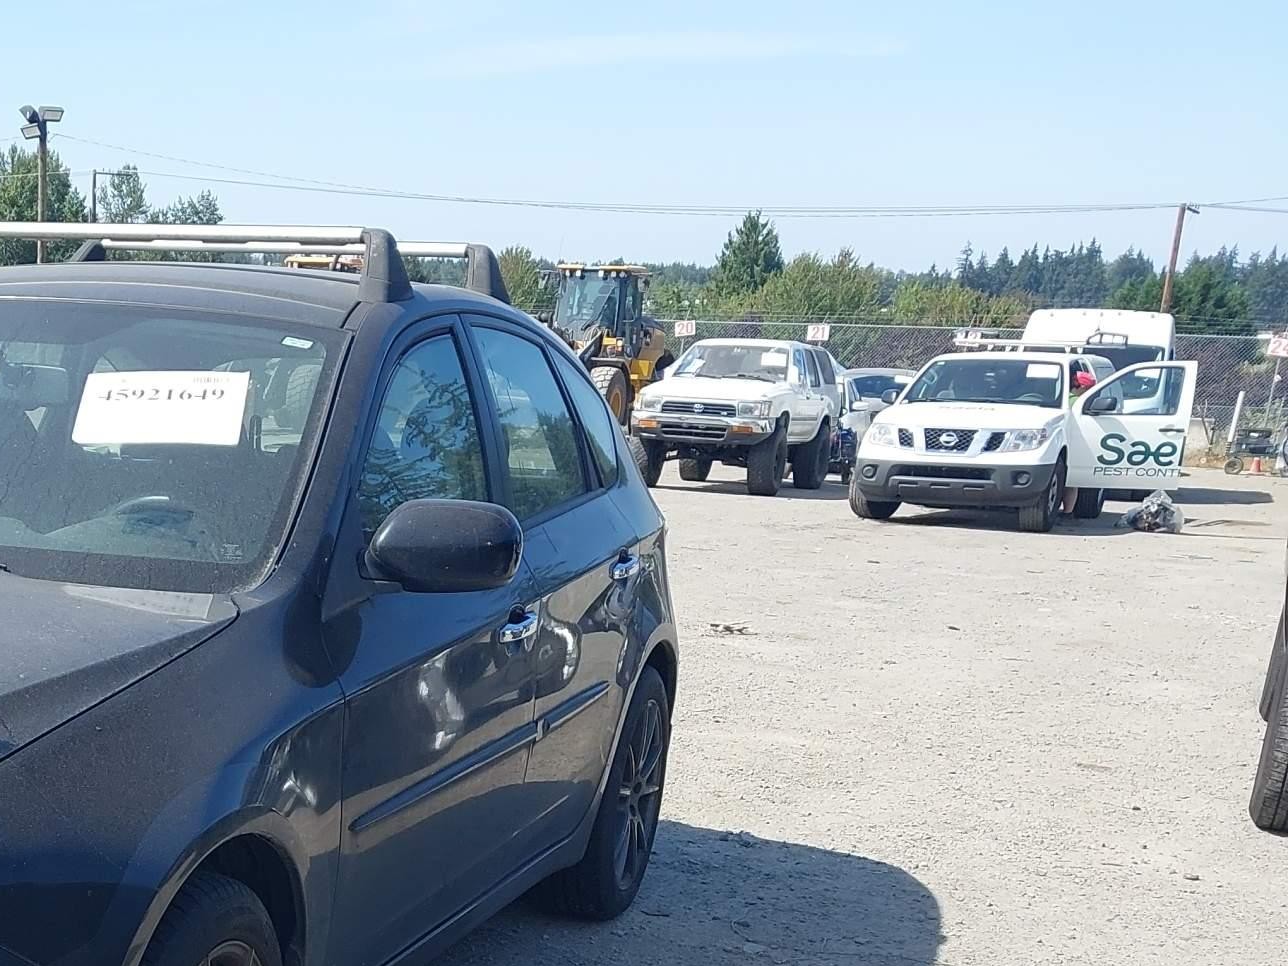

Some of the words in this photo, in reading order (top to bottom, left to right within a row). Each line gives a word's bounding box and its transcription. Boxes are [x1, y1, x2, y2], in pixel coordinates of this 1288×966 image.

[677, 321, 693, 335] 20
[811, 326, 826, 339] 21
[98, 389, 225, 401] 45921649
[1093, 466, 1133, 477] PEST
